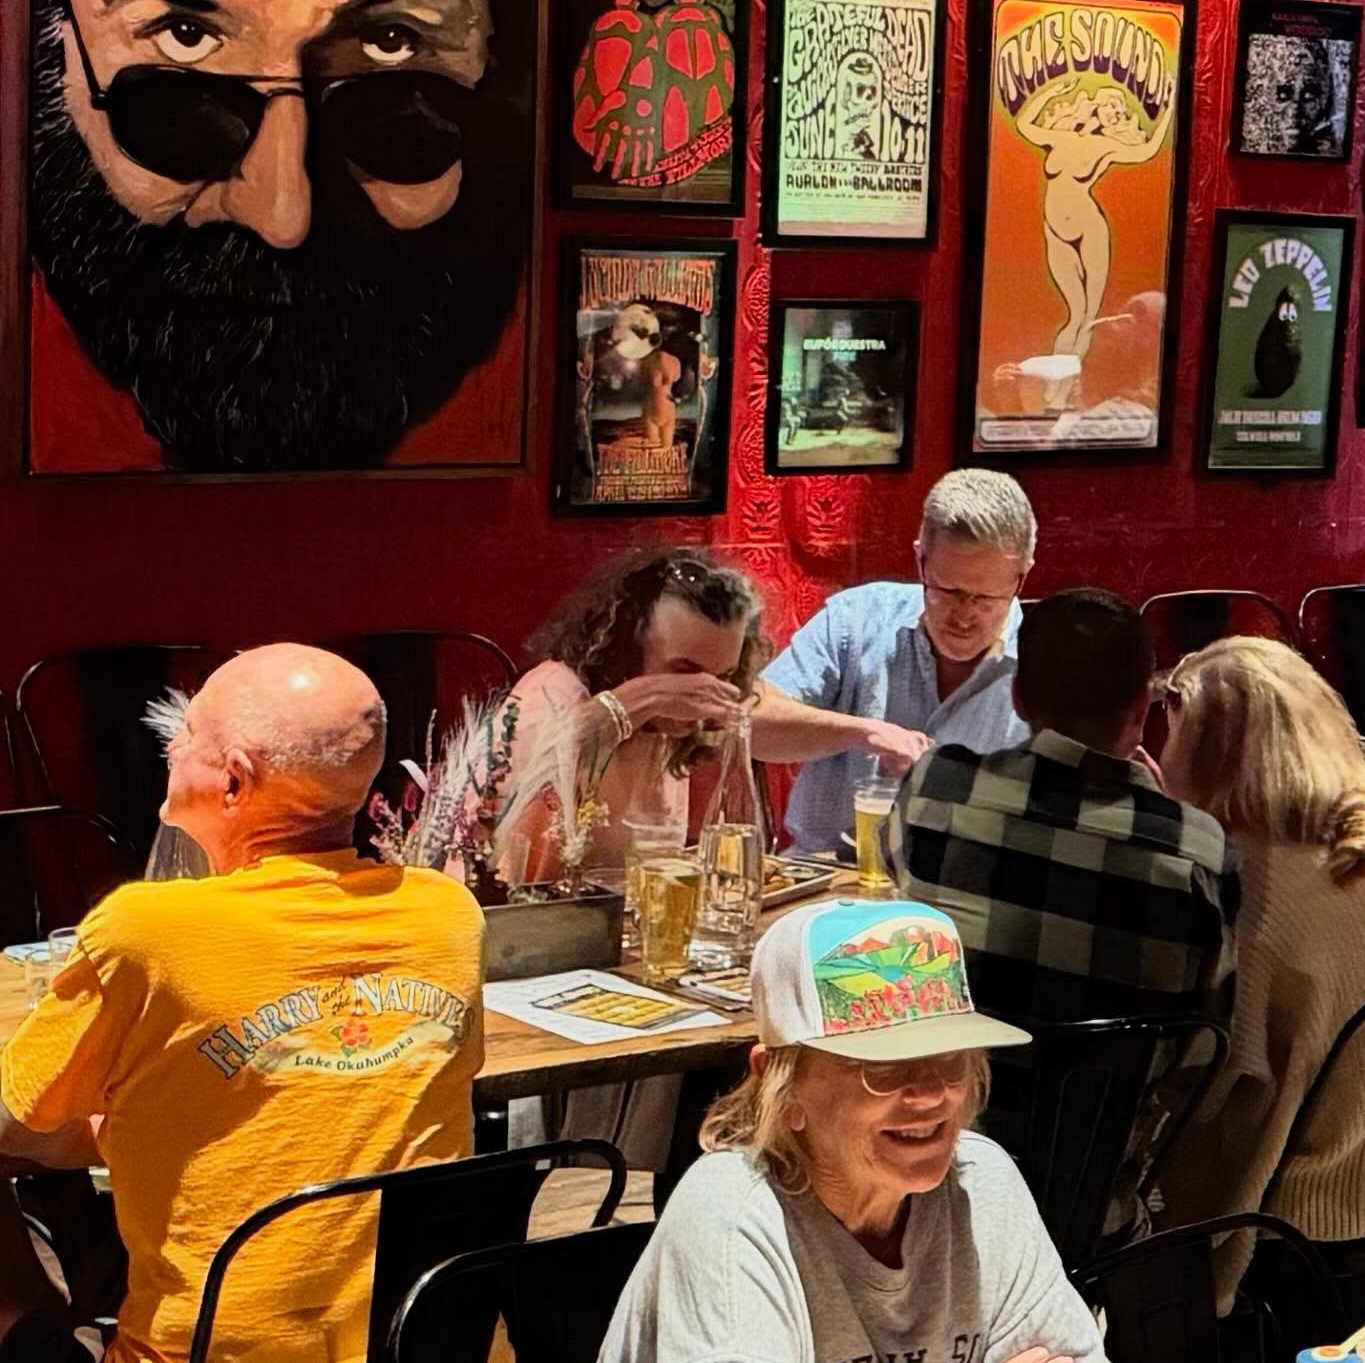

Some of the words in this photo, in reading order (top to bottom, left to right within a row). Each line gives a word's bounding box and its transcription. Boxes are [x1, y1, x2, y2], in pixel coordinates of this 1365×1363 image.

[787, 2, 887, 83] GRATEFUL
[884, 7, 931, 83] DEAD
[997, 11, 1069, 117] THE
[1069, 7, 1165, 121] SOUND
[785, 86, 837, 160] JUNE
[852, 175, 923, 193] BALLROOM
[1227, 257, 1261, 309] LED
[1258, 238, 1333, 312] ZEPPELIN
[198, 984, 324, 1080] HARRY
[322, 974, 347, 1004] and
[350, 971, 476, 1048] NATIVES
[294, 1054, 333, 1071] Lake
